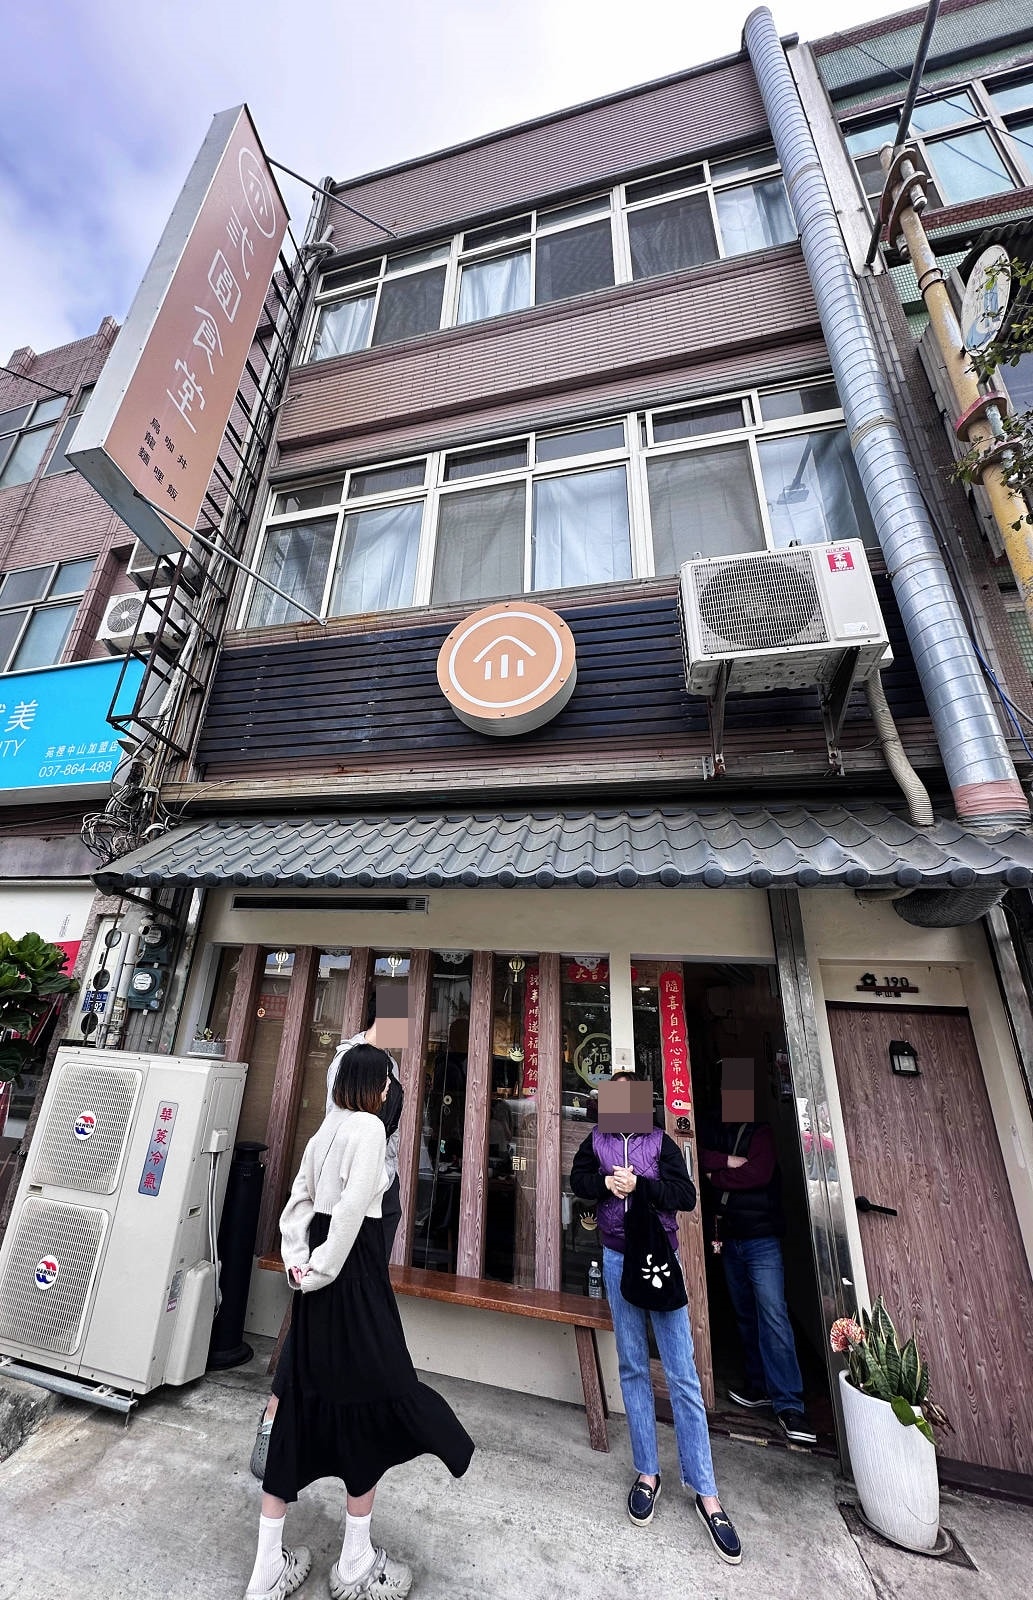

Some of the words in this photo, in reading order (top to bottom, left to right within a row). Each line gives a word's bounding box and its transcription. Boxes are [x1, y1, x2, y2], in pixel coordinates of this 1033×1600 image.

[138, 417, 161, 468] 烏龍麵
[153, 437, 175, 487] 咖哩
[166, 453, 188, 502] 丼飯
[0, 699, 39, 733] 美
[38, 760, 113, 778] 037-864-488
[884, 976, 909, 988] 190
[665, 980, 685, 1094] 隨喜自在心常樂
[143, 1107, 173, 1190] 華菱冷氣
